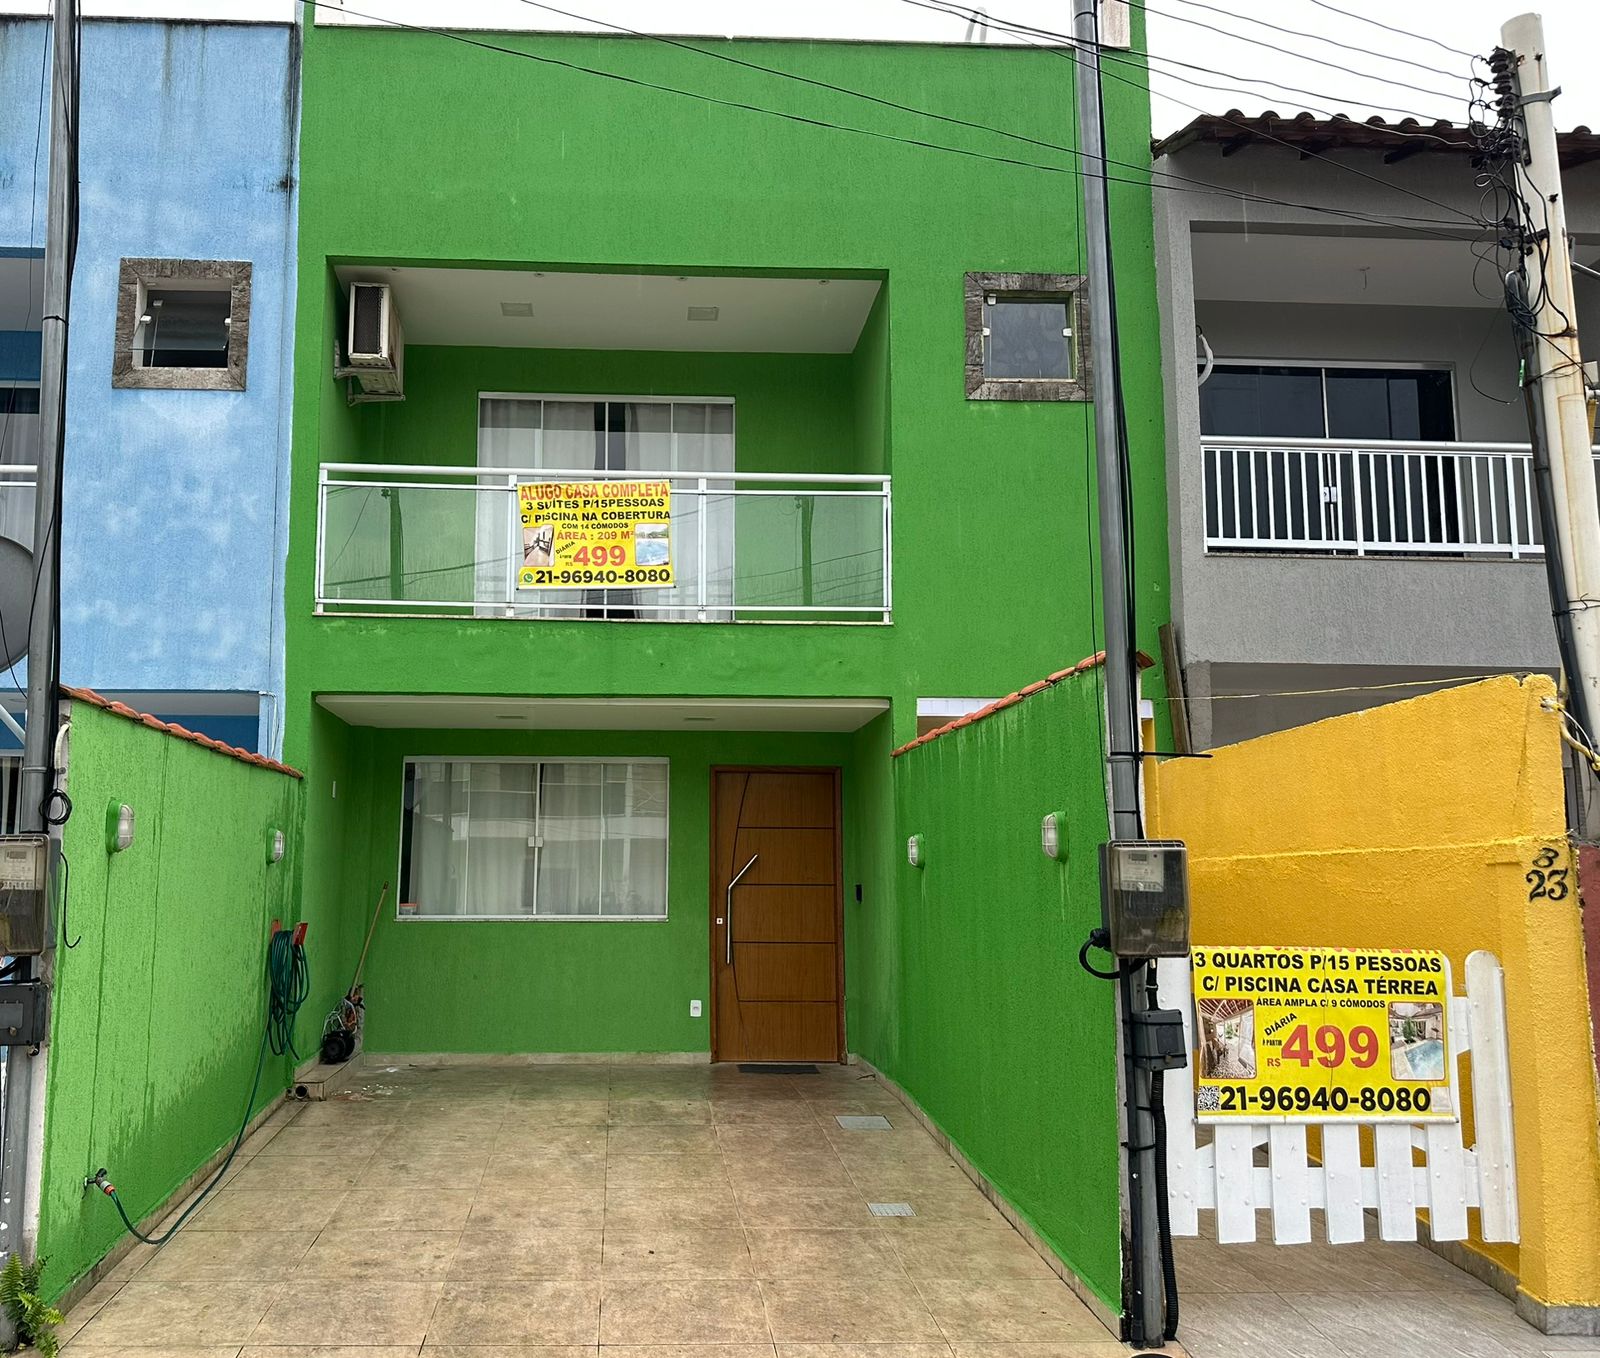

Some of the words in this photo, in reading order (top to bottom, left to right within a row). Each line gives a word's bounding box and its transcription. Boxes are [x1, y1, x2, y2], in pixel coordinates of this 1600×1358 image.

[521, 485, 563, 500] ALUGO
[565, 484, 598, 499] CASA
[603, 483, 668, 497] COMPLETA
[526, 502, 533, 510] 3
[537, 498, 579, 509] SUÍTES
[521, 514, 532, 523] C/
[535, 512, 578, 523] PISCINA
[602, 511, 670, 520] COBERTURA
[557, 530, 587, 540] ÁREA
[598, 532, 617, 540] 209
[573, 546, 626, 566] 499
[536, 570, 670, 583] 21-96940-8080
[1526, 868, 1568, 902] 23
[1194, 953, 1205, 968] 3
[1213, 953, 1304, 970] QUARTOS
[1310, 954, 1350, 971] P/15
[1356, 956, 1441, 973] PESSOAS
[1202, 976, 1220, 991] C/
[1226, 976, 1301, 993] PISCINA
[1308, 978, 1358, 994] CASA
[1364, 976, 1438, 995] TÉRREA
[1256, 997, 1282, 1006] ÁREA
[1340, 998, 1385, 1008] CÔMODOS
[1264, 1012, 1297, 1036] DIÁRIA
[1281, 1025, 1379, 1068] 499
[1220, 1086, 1431, 1112] 21-96940-8080
